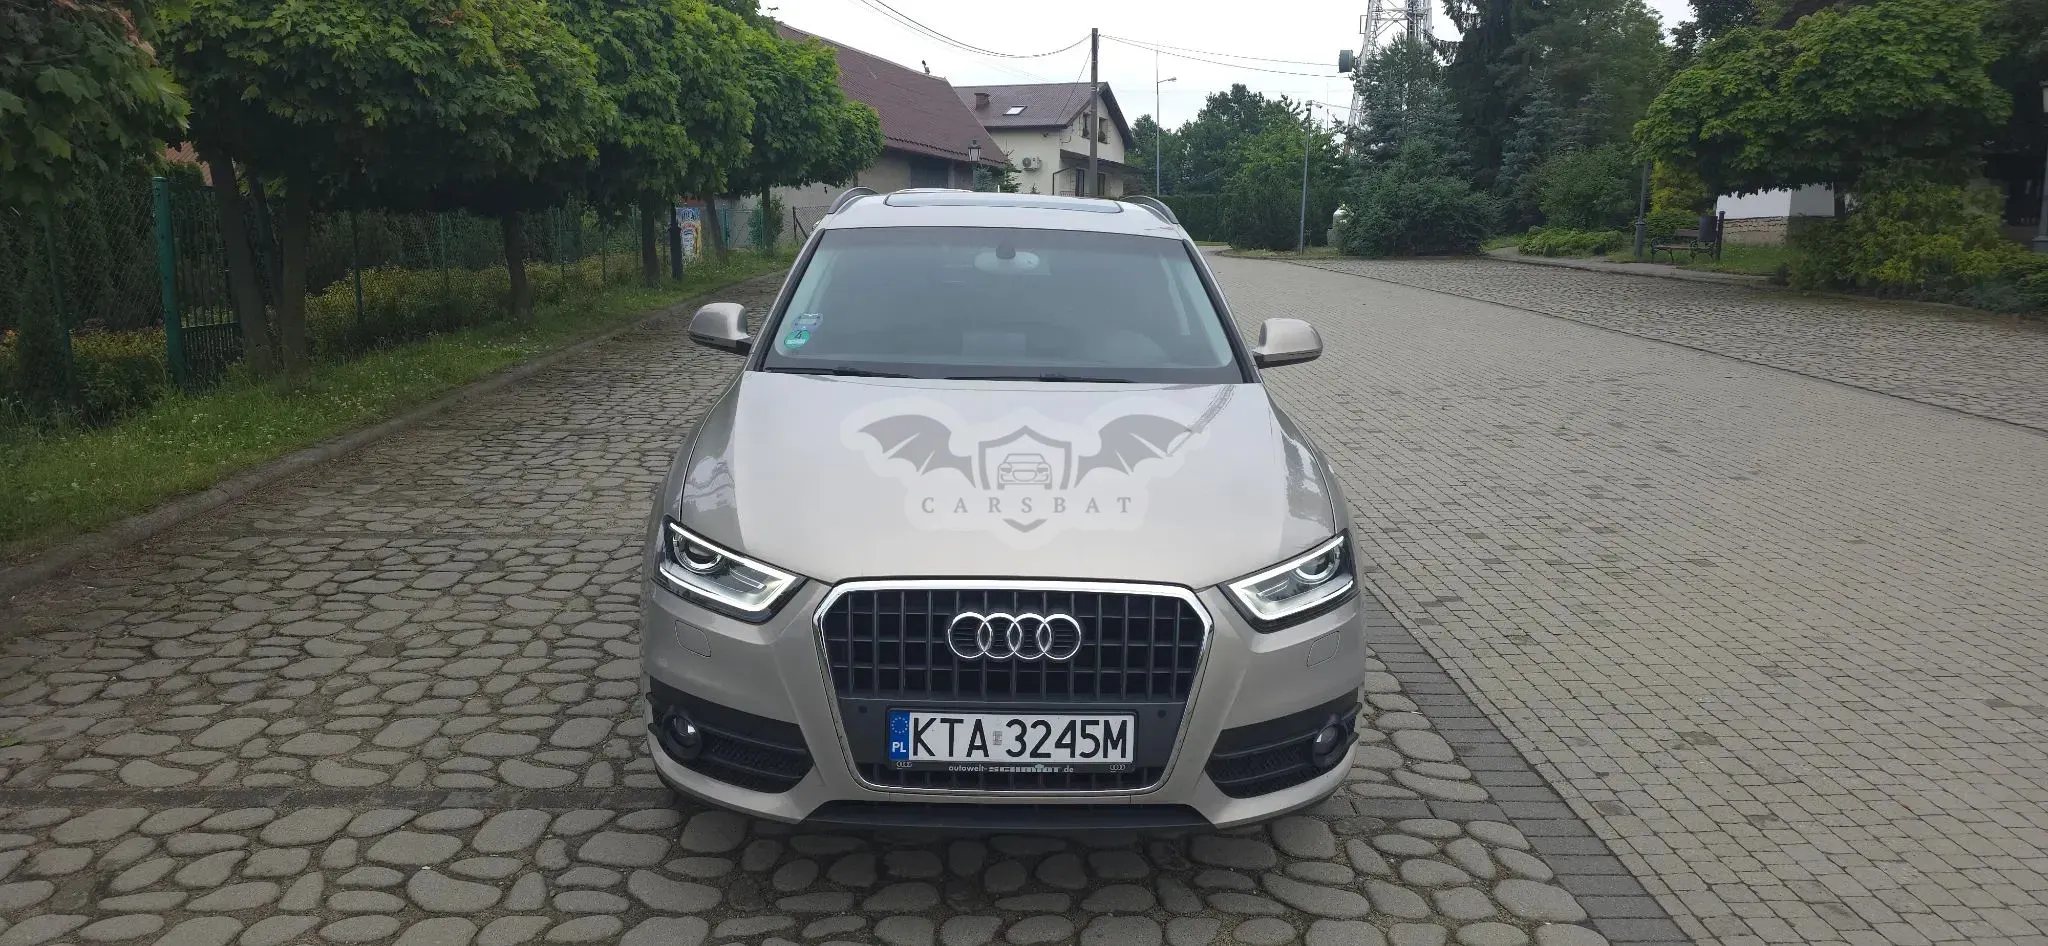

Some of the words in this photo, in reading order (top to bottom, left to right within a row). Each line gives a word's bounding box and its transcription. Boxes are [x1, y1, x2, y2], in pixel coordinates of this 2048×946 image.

[892, 741, 907, 753] PL
[912, 717, 990, 758] KTA
[1005, 718, 1127, 759] 3245M
